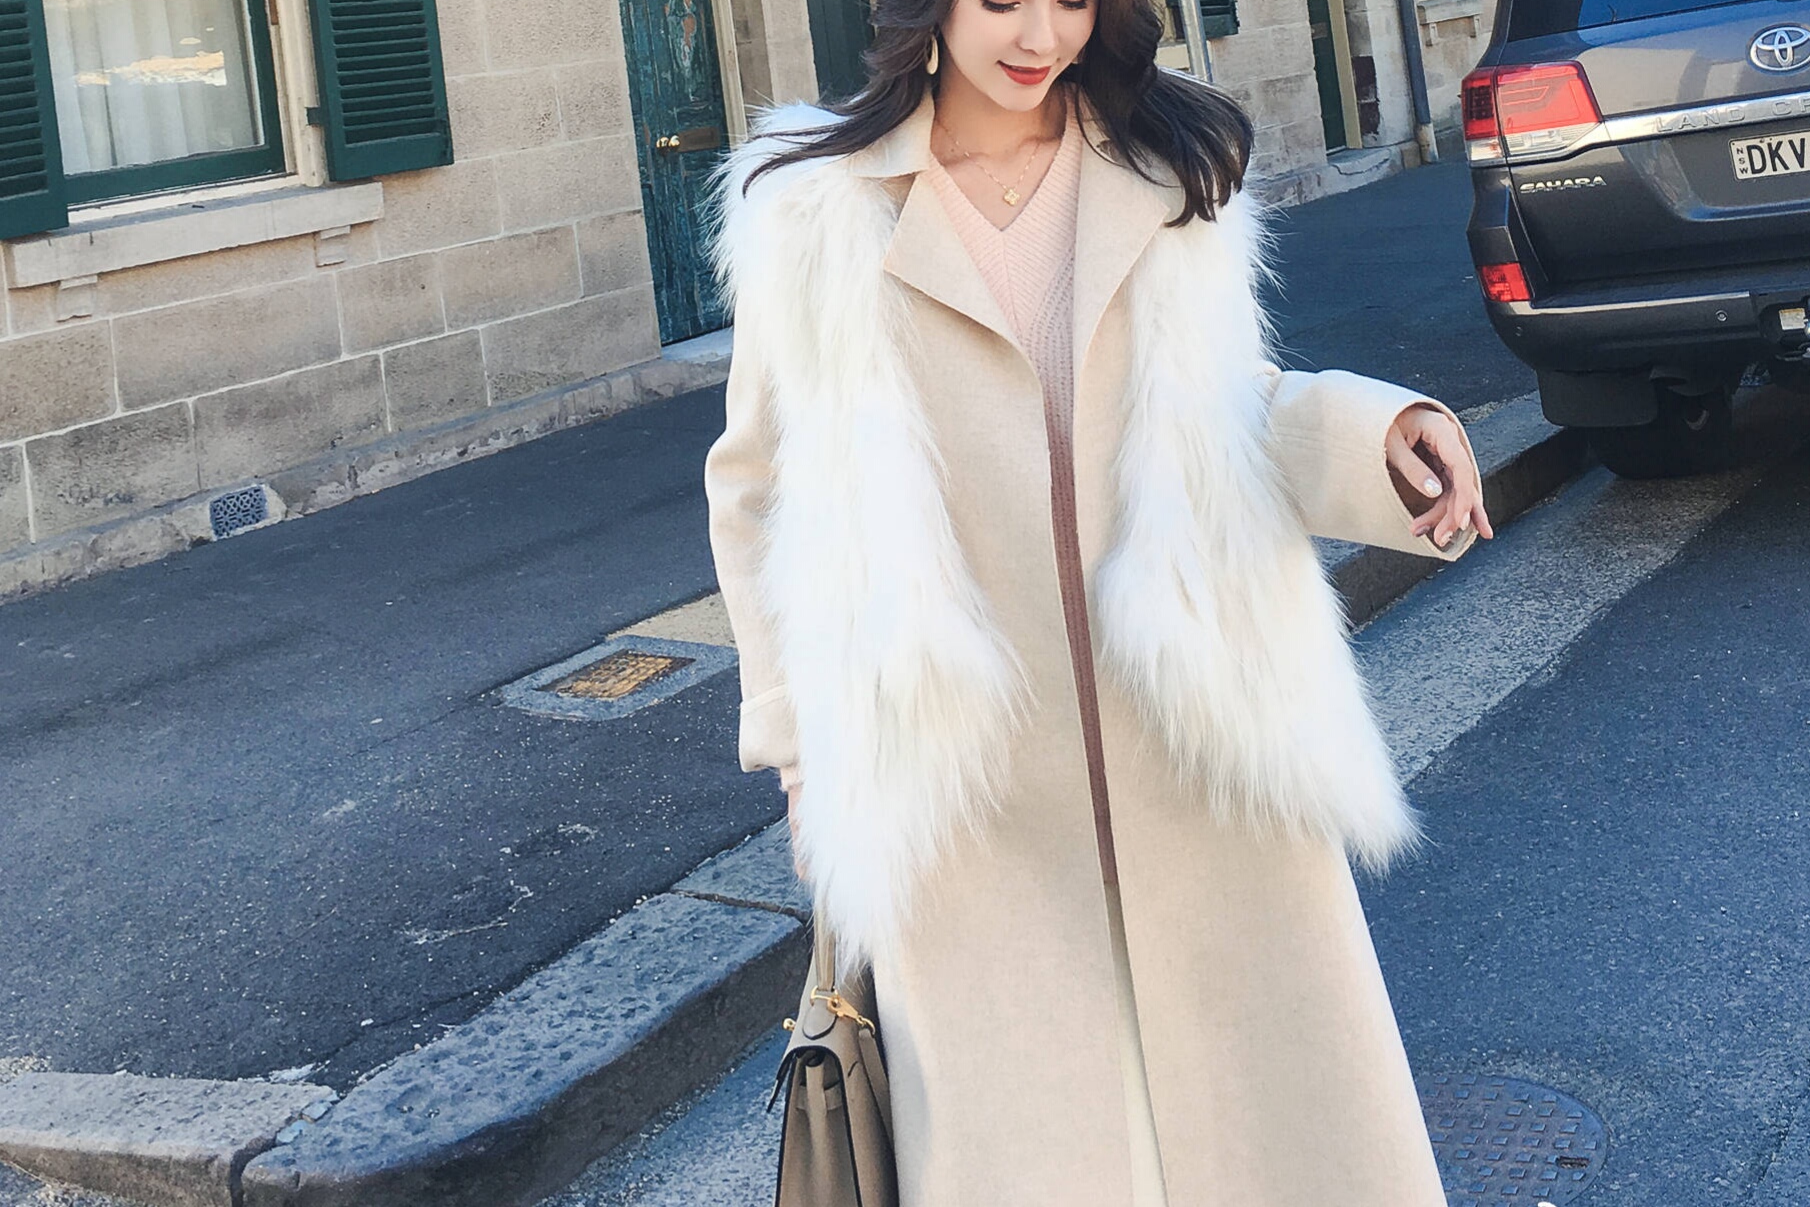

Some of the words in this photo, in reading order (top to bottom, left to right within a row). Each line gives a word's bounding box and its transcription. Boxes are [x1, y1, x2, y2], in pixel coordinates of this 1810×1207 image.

[1656, 105, 1746, 133] LAND
[1746, 138, 1806, 175] DKV
[1520, 175, 1607, 194] SAHARA
